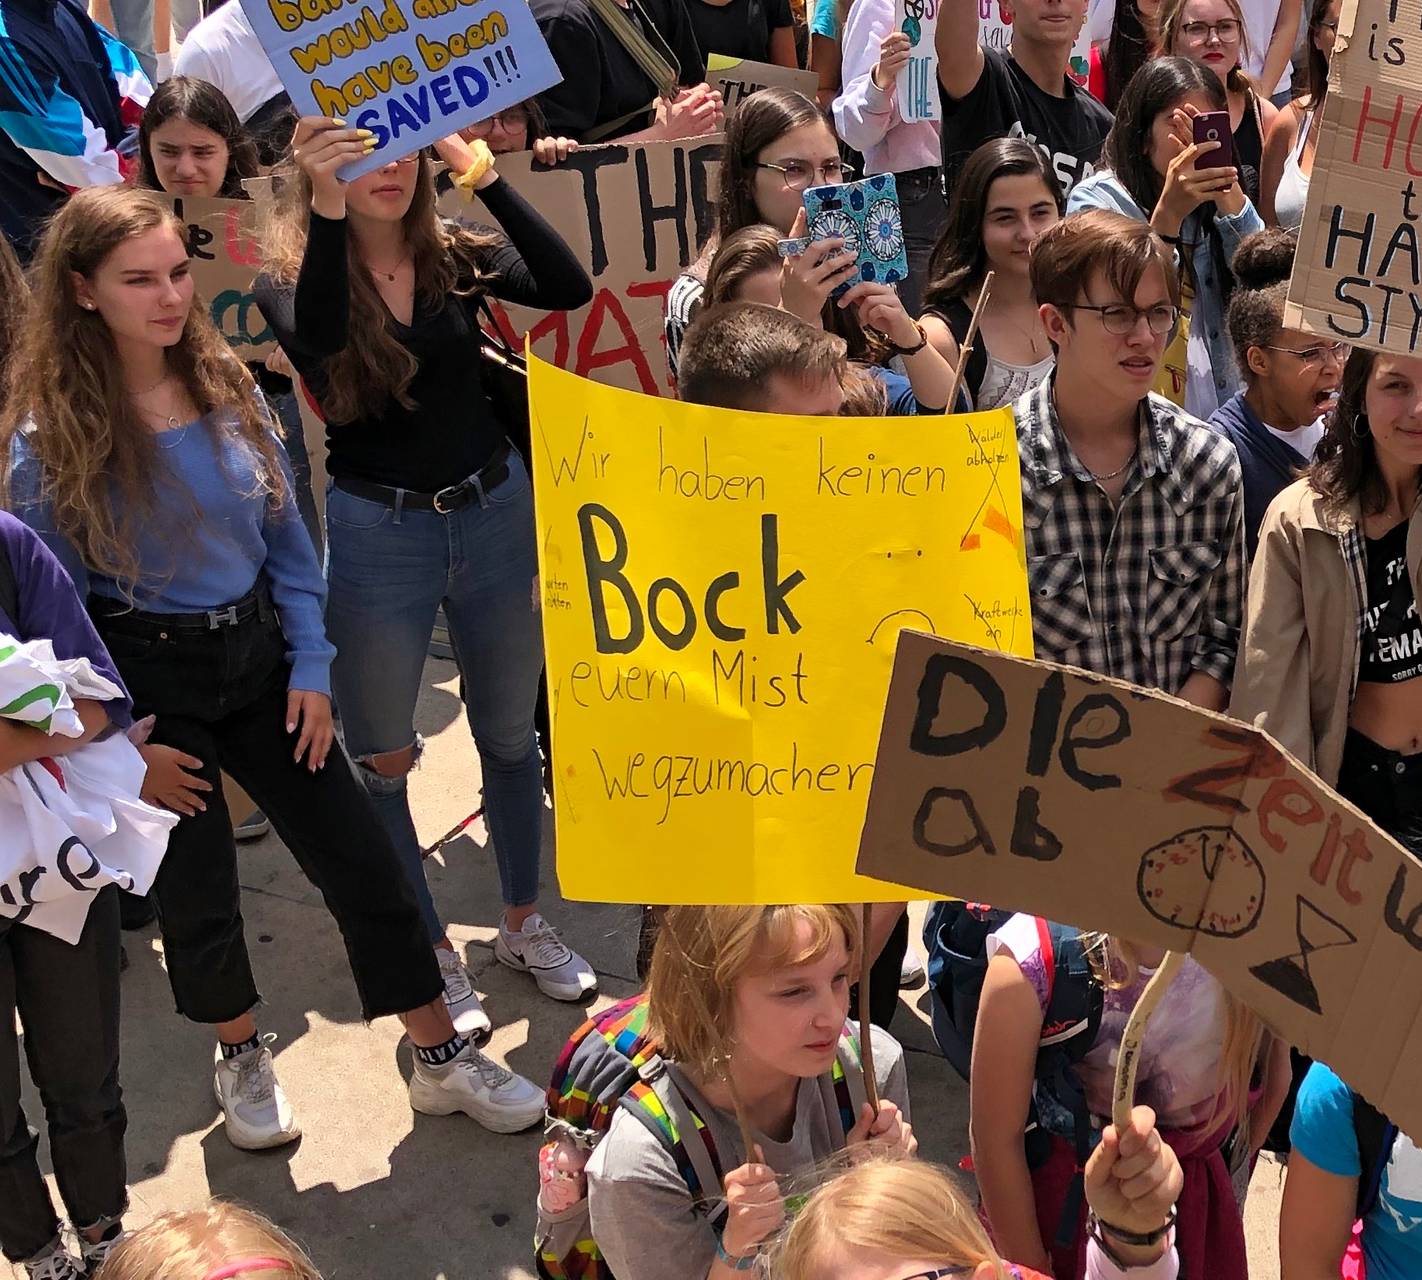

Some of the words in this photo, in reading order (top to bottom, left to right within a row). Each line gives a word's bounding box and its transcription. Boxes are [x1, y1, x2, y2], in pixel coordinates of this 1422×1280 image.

[311, 54, 418, 117] have
[415, 11, 508, 72] been
[1368, 23, 1406, 66] is
[533, 410, 611, 488] Wir
[658, 424, 765, 501] haben
[817, 436, 945, 496] keinen
[577, 502, 806, 662] Bock
[570, 660, 686, 707] euern
[712, 649, 809, 708] Mist
[912, 786, 1064, 862] ab
